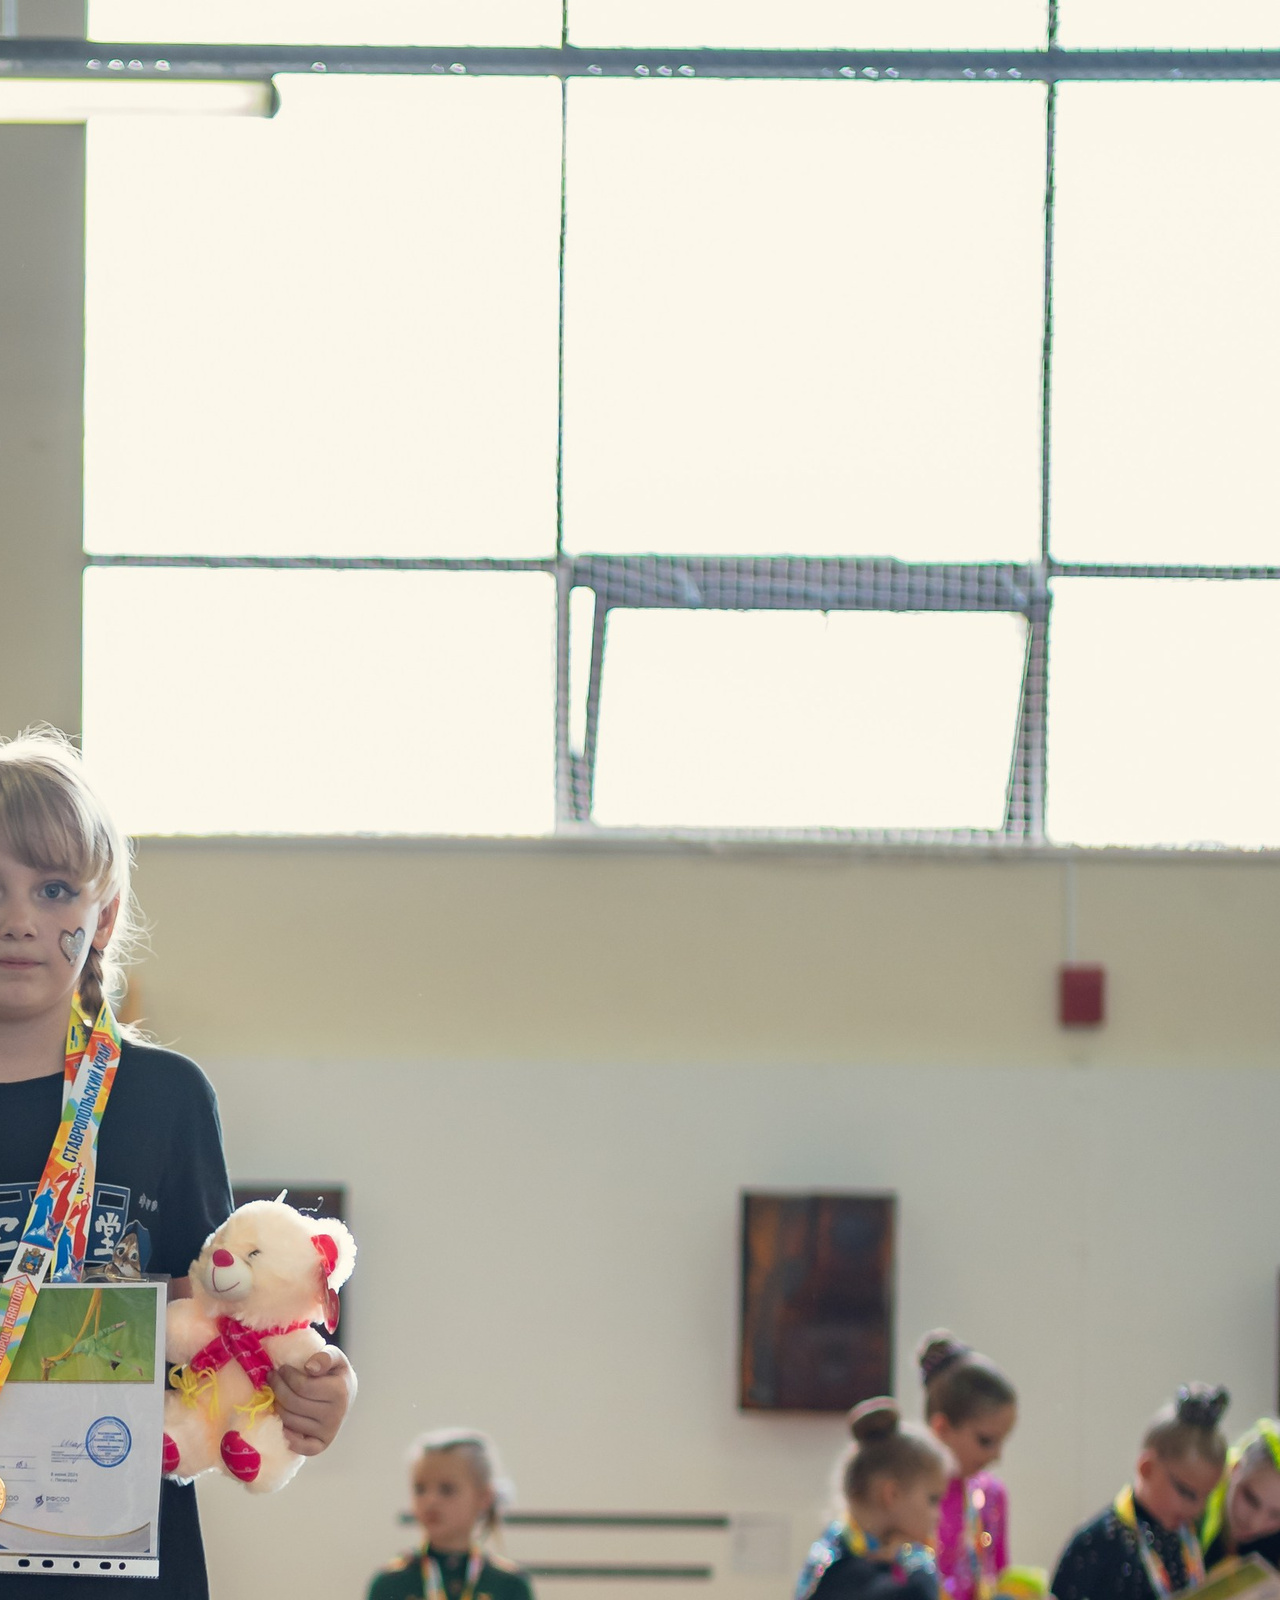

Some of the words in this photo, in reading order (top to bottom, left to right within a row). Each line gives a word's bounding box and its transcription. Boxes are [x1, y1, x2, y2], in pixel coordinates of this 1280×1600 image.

[62, 1068, 104, 1164] СТАВРОПОЛЬСКИЙ
[92, 1041, 113, 1073] КРАЙ
[2, 1280, 27, 1330] TERRITORY
